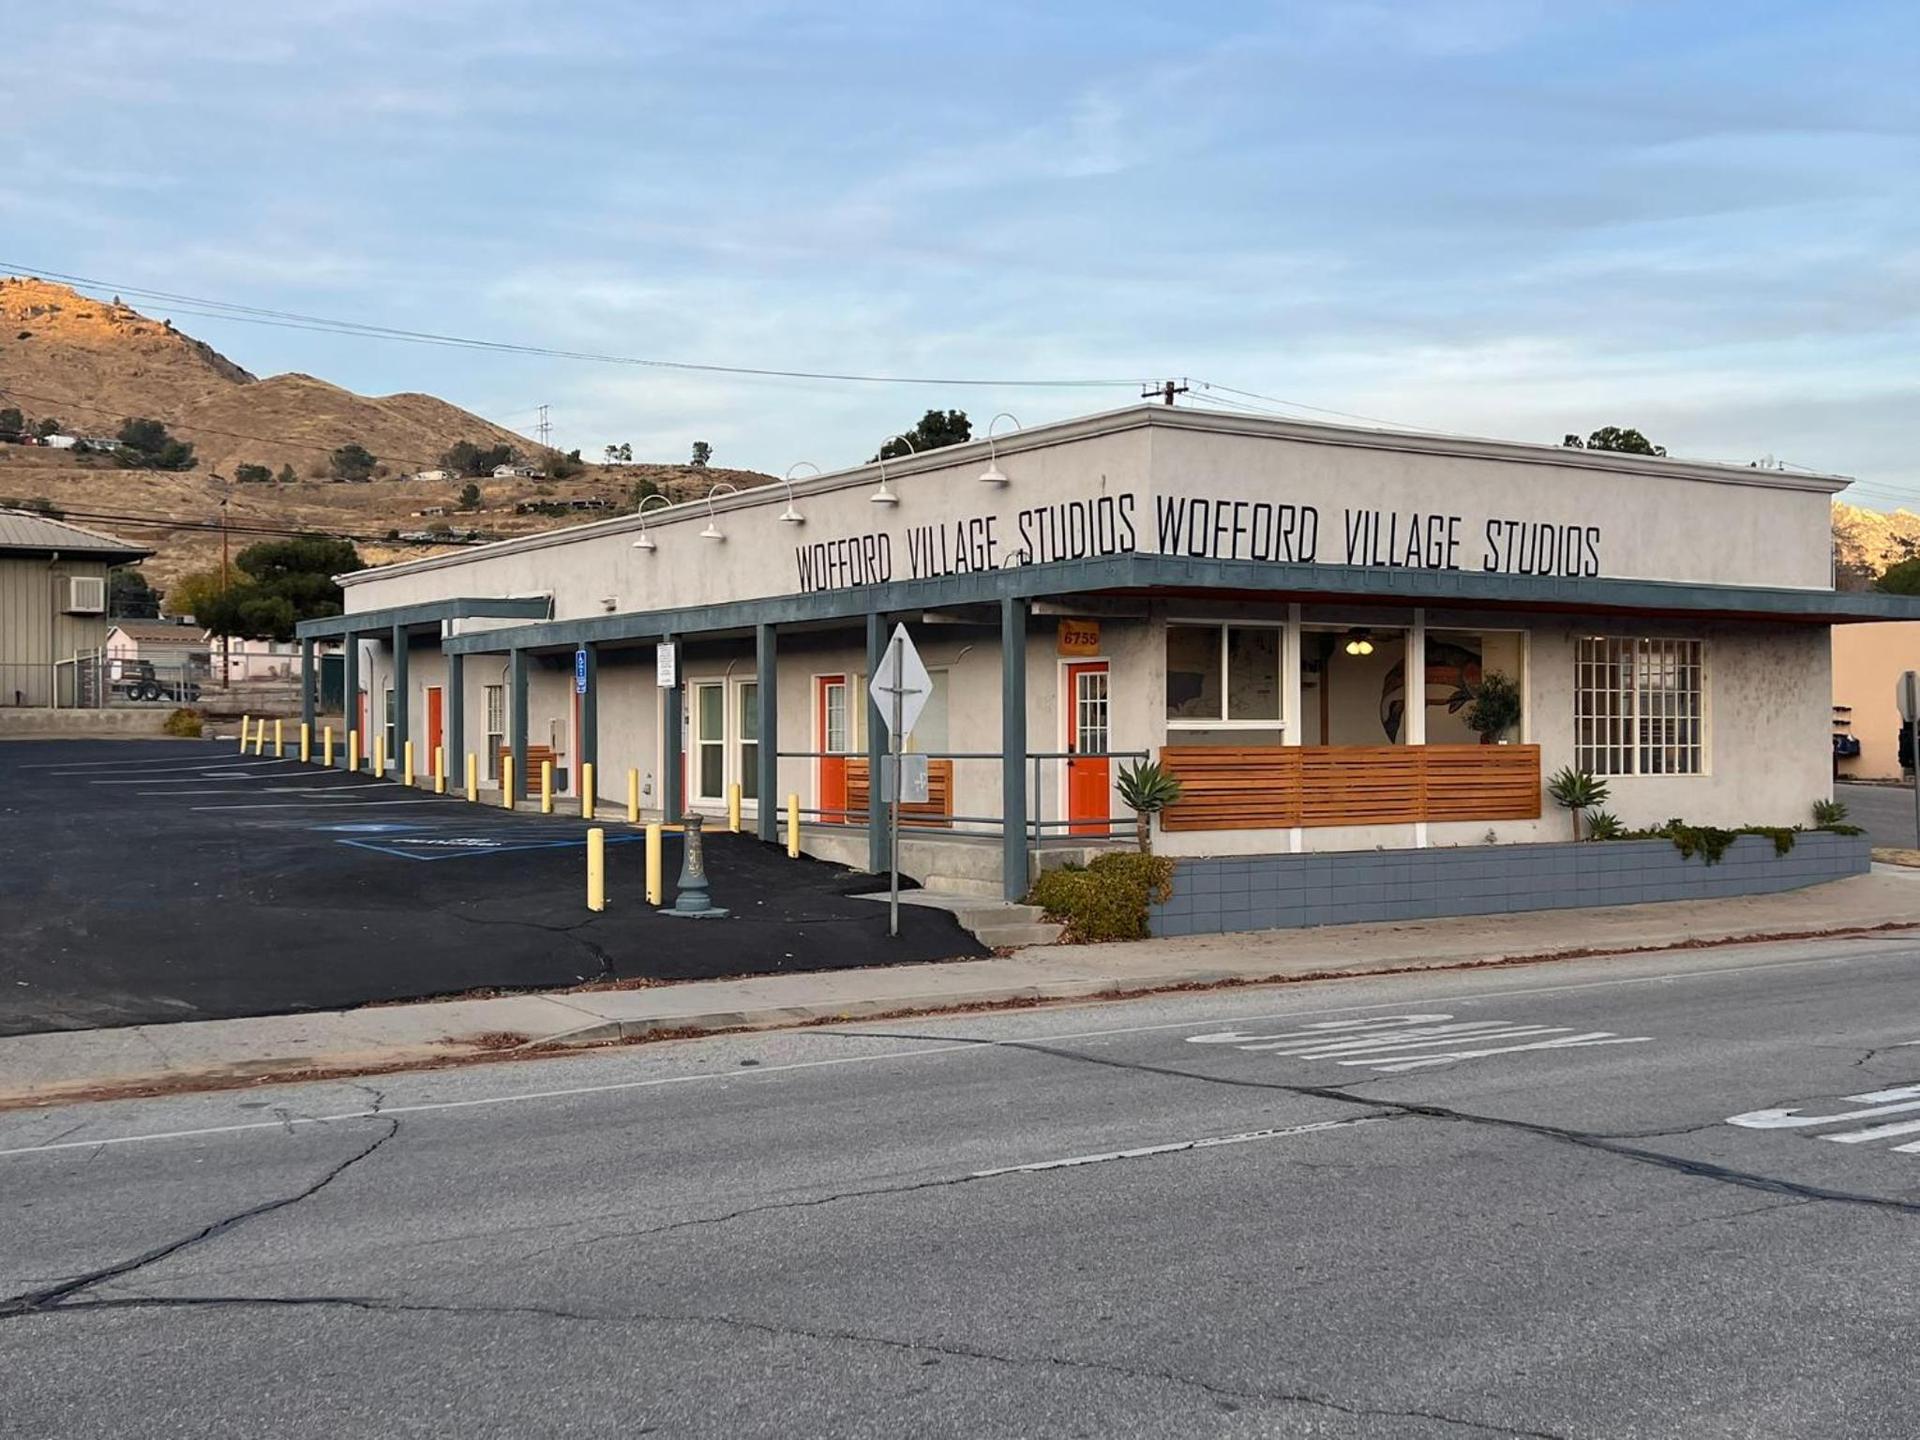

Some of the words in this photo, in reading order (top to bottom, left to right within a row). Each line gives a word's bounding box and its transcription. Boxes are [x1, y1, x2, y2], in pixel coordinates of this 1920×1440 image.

[796, 533, 892, 593] WOFFORD
[907, 516, 999, 580] VILLAGE
[1018, 493, 1136, 566] STUDIOS
[1157, 495, 1318, 564] WOFFORD
[1345, 508, 1462, 570] VILLAGE
[1485, 519, 1601, 578] STUDIOS
[1064, 632, 1097, 646] 6755
